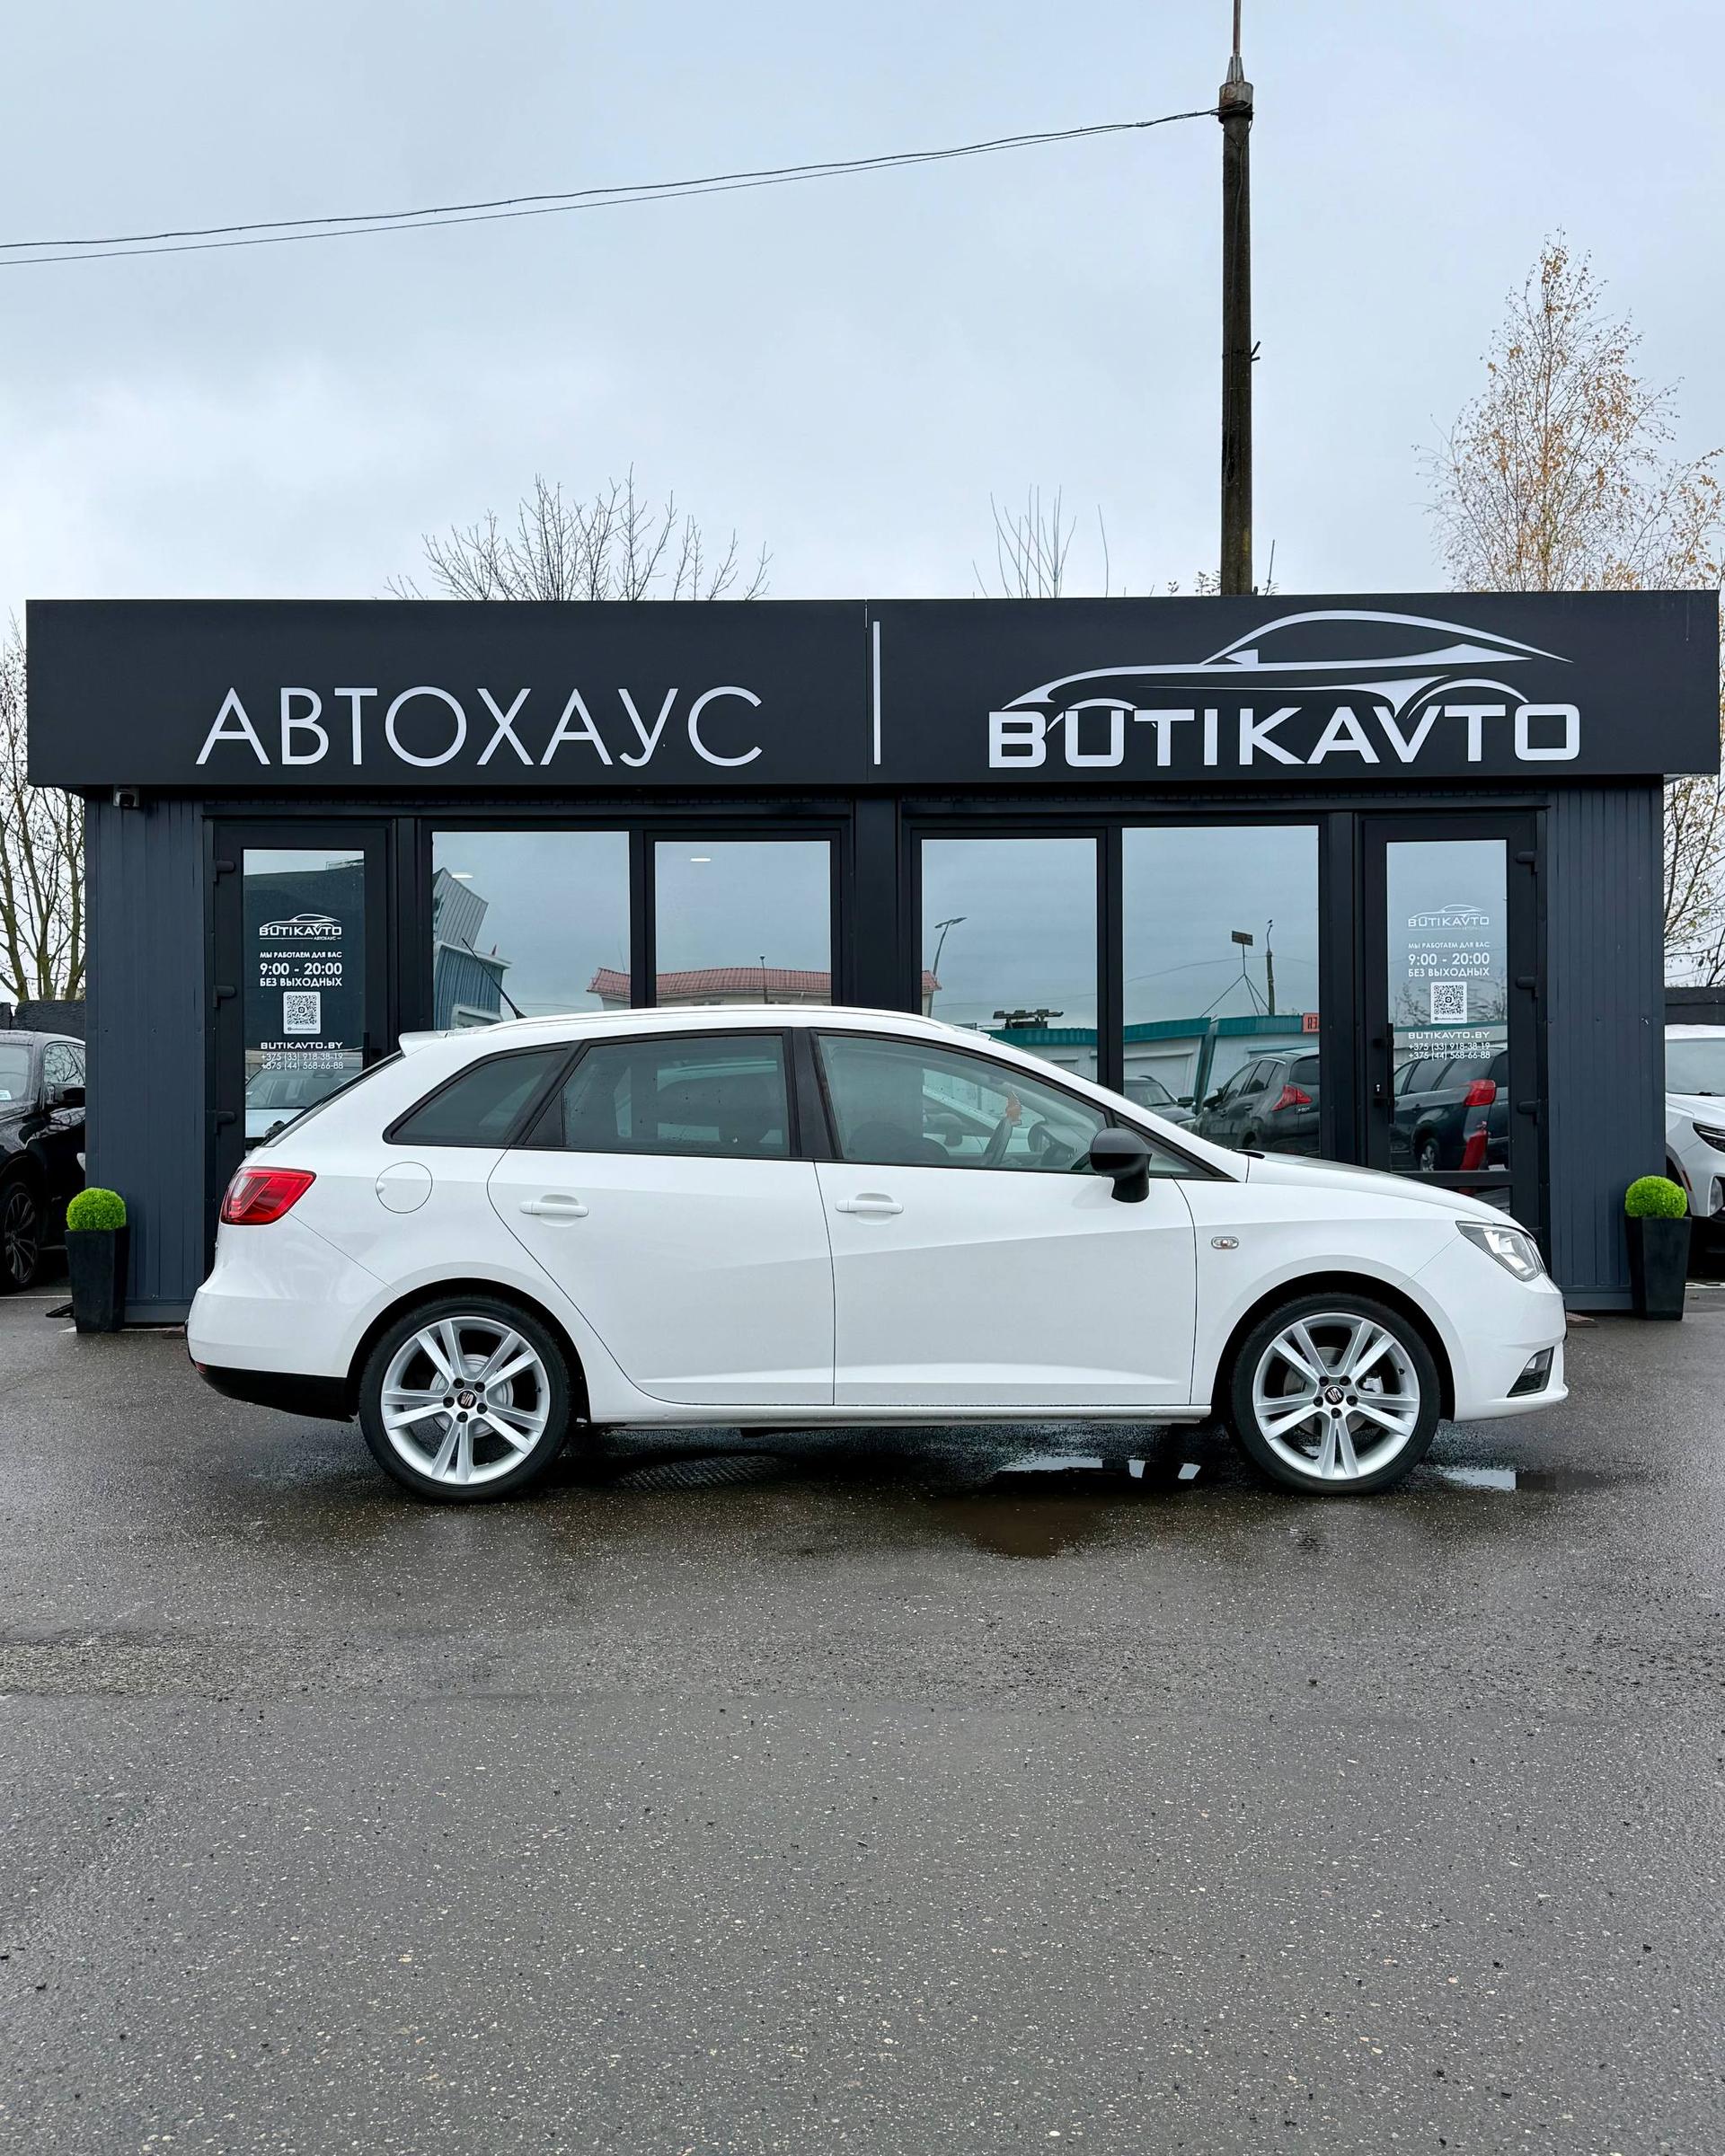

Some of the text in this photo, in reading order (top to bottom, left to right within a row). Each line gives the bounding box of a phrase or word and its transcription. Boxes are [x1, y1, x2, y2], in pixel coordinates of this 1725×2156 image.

[196, 686, 764, 767] АВТОХАУС
[988, 704, 1580, 768] BUTIKAVTO
[1408, 916, 1490, 927] BUTIKAVTO
[260, 926, 342, 936] BUTIKAVTO
[1408, 954, 1438, 966] 9:00
[1452, 952, 1490, 965] 20:00
[260, 963, 289, 975] 9:00
[304, 963, 342, 975] 20:00
[1408, 968, 1490, 977] БЕЗ ВЫХОДНЫХ
[260, 977, 342, 987] БЕЗ ВЫХОДНЫХ
[1408, 1031, 1491, 1039] BUTIKAVTO.BY
[1431, 1043, 1447, 1052] (33)
[1449, 1042, 1491, 1050] 918-38-19
[1450, 1051, 1491, 1059] 568-66-88
[284, 1062, 300, 1071] (44)
